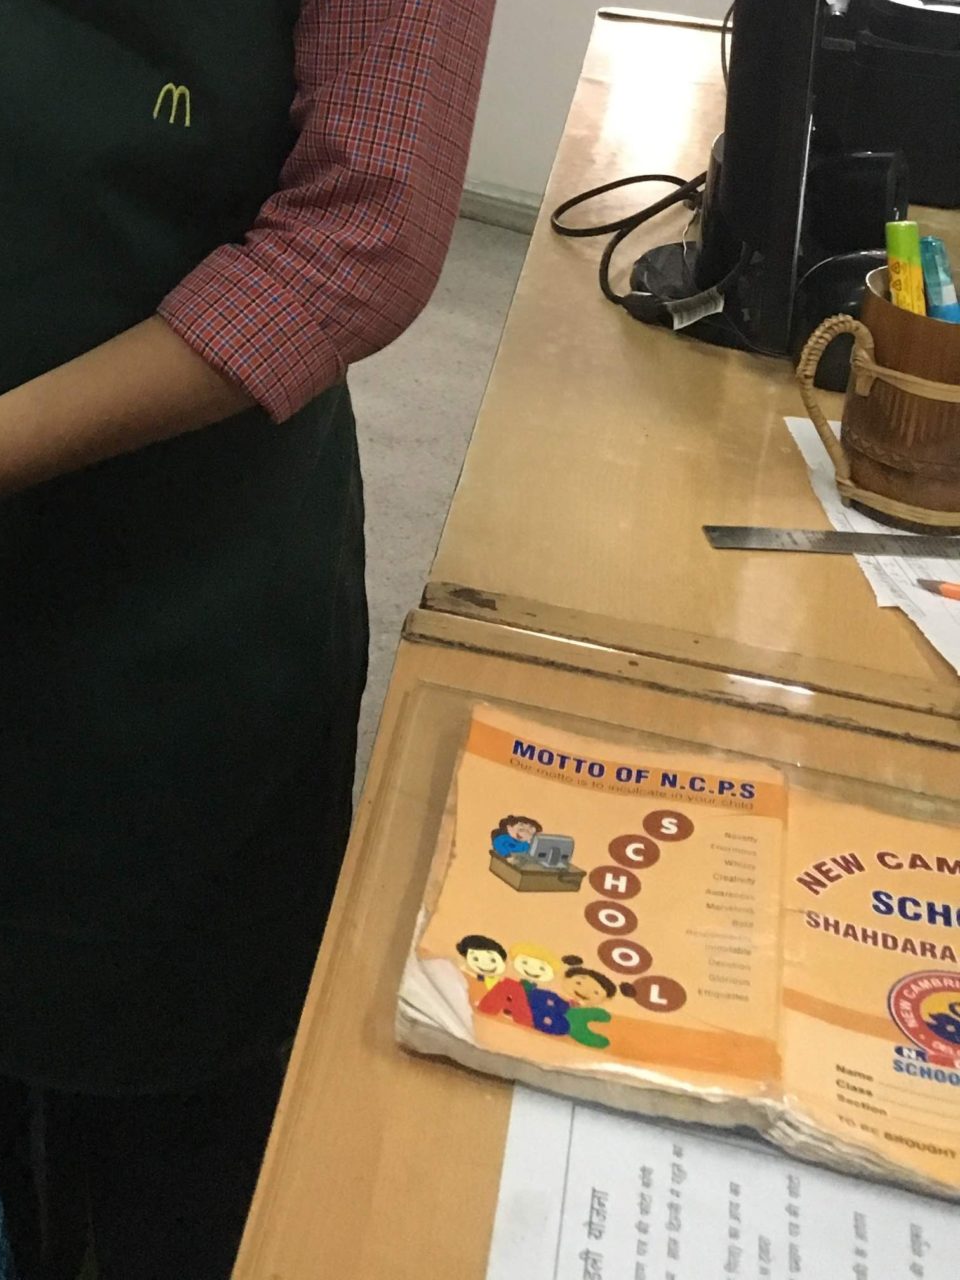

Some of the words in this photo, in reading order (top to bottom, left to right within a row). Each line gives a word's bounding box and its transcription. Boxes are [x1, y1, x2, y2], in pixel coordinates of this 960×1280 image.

[512, 739, 605, 778] MOTTO
[616, 767, 650, 784] OF
[660, 772, 756, 799] N.C.P.S
[796, 852, 865, 896] NEW
[876, 851, 960, 875] CAM
[872, 890, 960, 928] SCH
[806, 910, 957, 963] SHAHDARA
[836, 1064, 874, 1081] Name
[836, 1079, 874, 1097] Class
